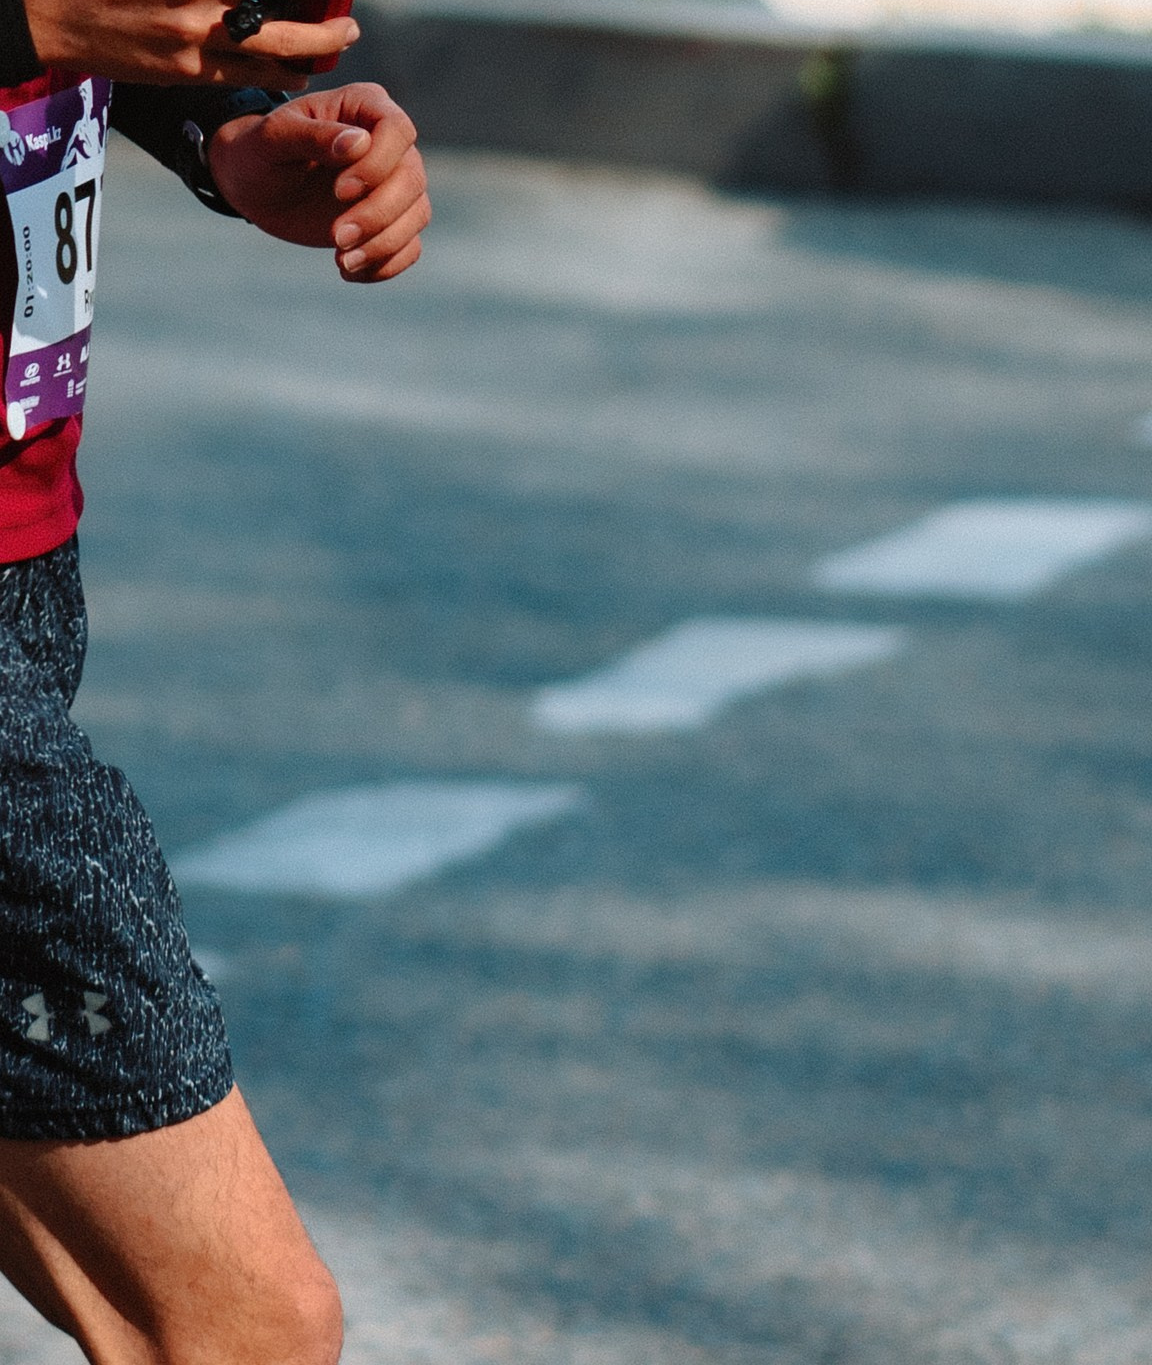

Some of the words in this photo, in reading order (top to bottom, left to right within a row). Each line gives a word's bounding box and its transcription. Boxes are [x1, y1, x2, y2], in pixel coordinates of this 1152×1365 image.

[24, 125, 62, 152] Kaspi.kz
[22, 225, 35, 319] 01:20:00
[54, 175, 103, 286] 87
